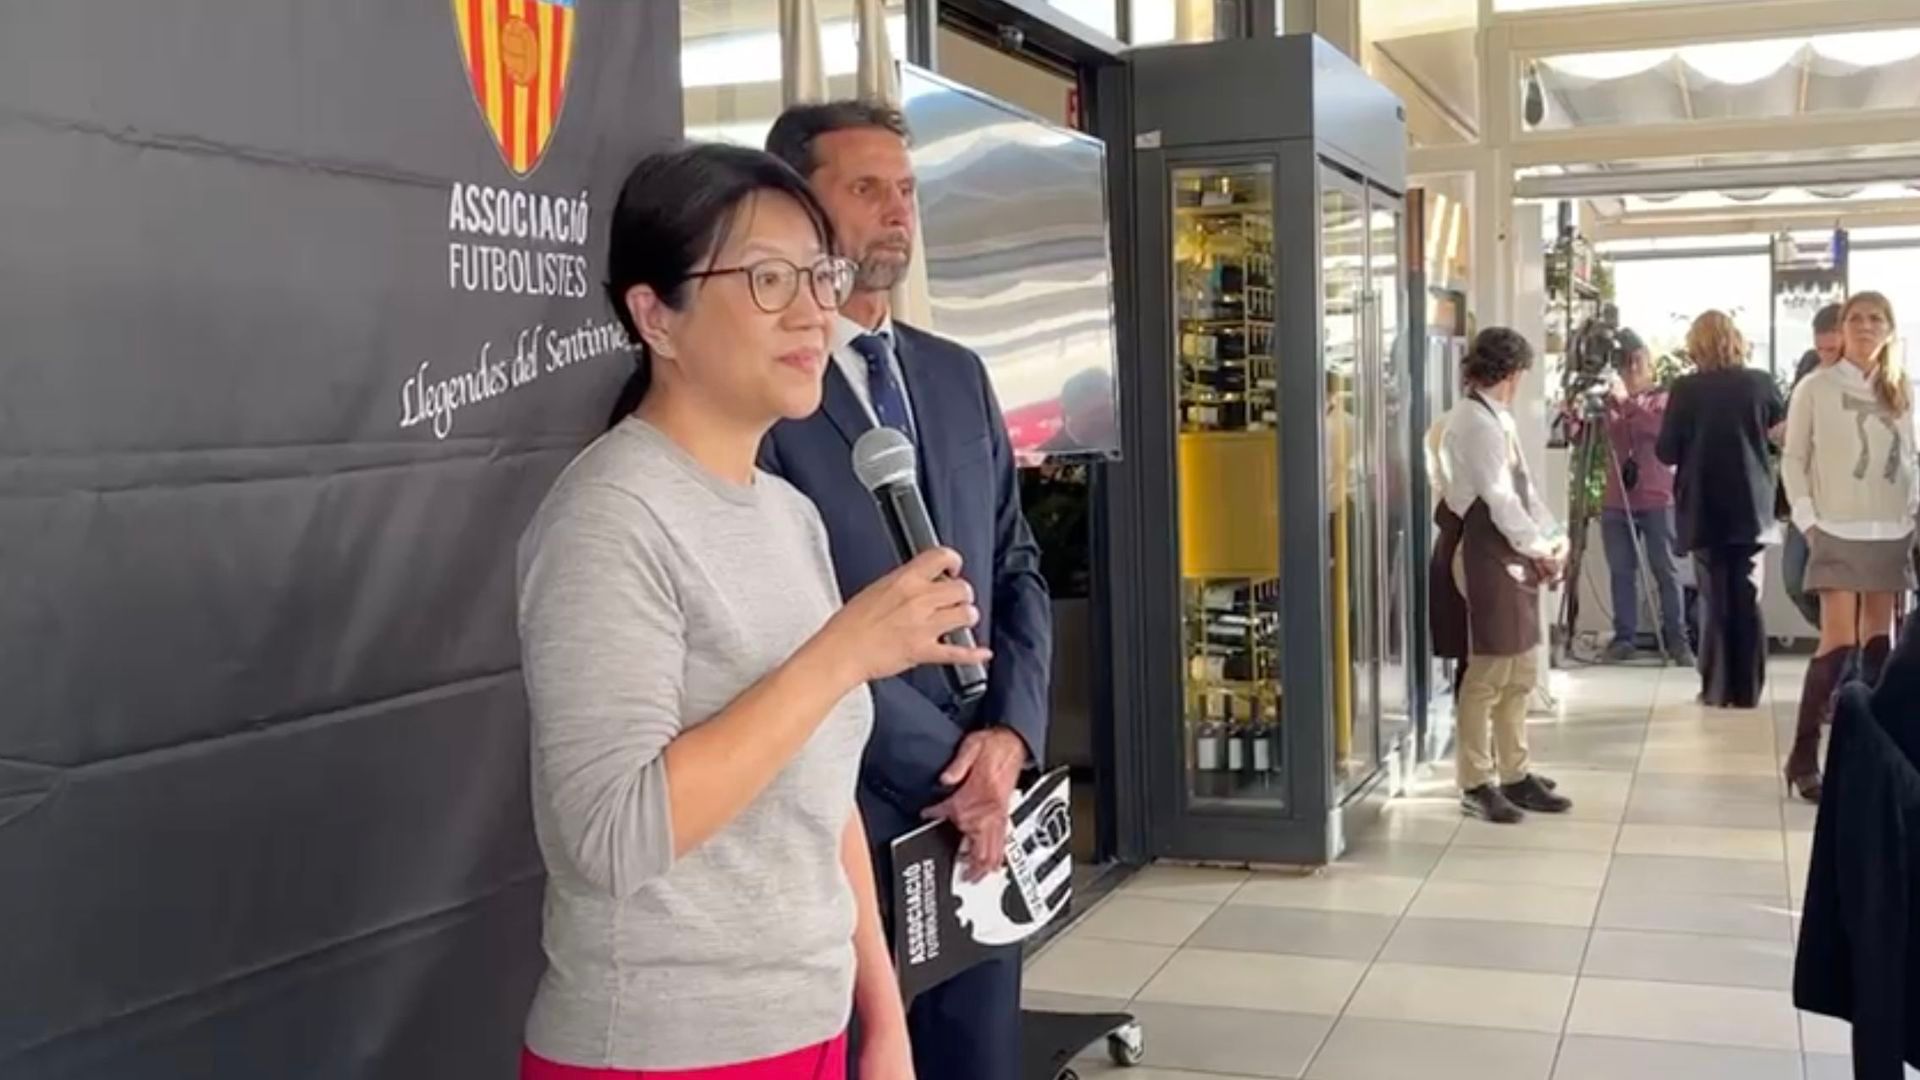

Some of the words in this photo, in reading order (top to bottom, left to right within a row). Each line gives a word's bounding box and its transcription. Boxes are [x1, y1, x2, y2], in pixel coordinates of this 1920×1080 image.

[449, 182, 589, 245] ASSOCIACIÓ
[450, 243, 587, 298] FUTBOLISTES
[400, 342, 508, 439] Llegendes
[512, 325, 543, 388] del
[545, 318, 641, 372] Sentime
